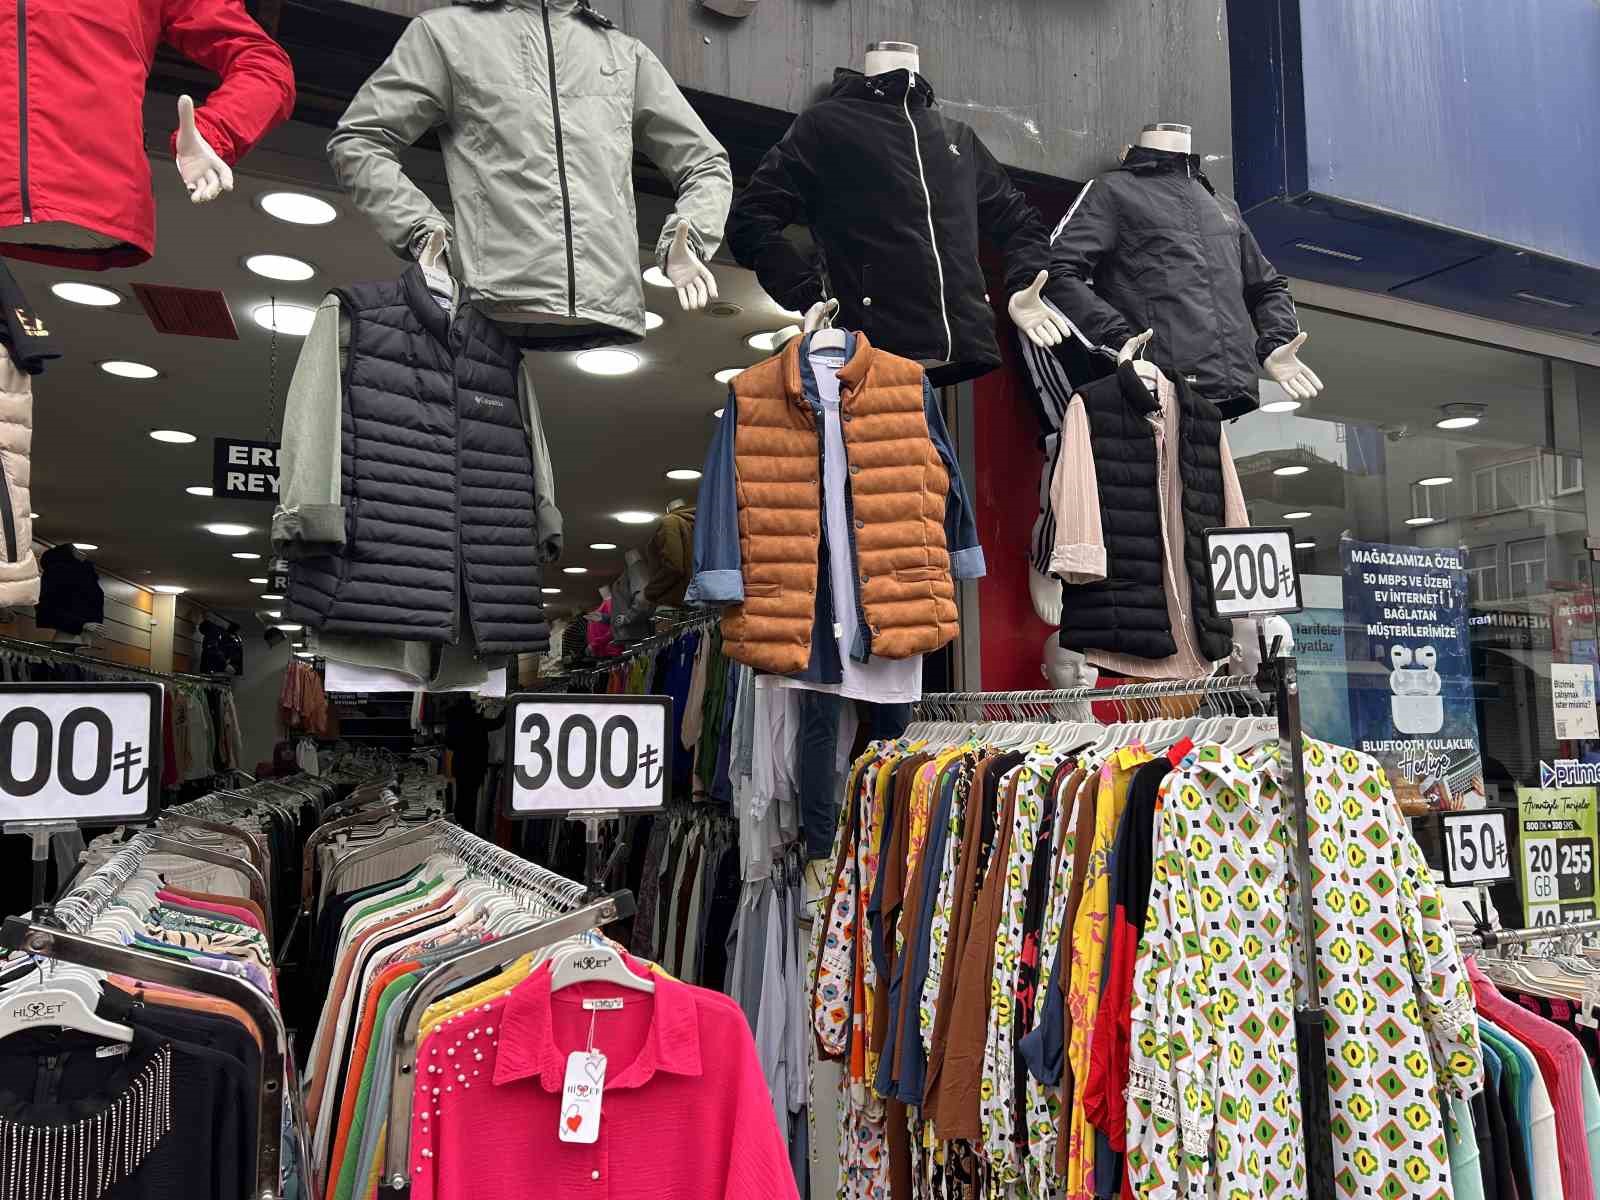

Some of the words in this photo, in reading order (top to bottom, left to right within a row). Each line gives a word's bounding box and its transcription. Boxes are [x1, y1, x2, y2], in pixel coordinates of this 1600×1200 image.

[1351, 548, 1433, 568] MAĞAZAMIZA
[1435, 553, 1463, 570] ÖZEL
[1363, 573, 1376, 585] 50
[1378, 574, 1407, 586] MBPS
[1409, 575, 1422, 587] VE
[1423, 574, 1452, 588] ÜZERİ
[1374, 590, 1388, 602] EV
[1384, 606, 1437, 621] BAĞLATAN
[1367, 622, 1457, 639] MÜŞTERİLERİMİZE
[514, 713, 664, 790] 300₺
[1362, 739, 1424, 752] BLUETOOTH
[1426, 739, 1474, 750] KULAKLIK
[1529, 845, 1552, 873] 20
[1560, 845, 1592, 875] 255
[1535, 875, 1552, 897] GB
